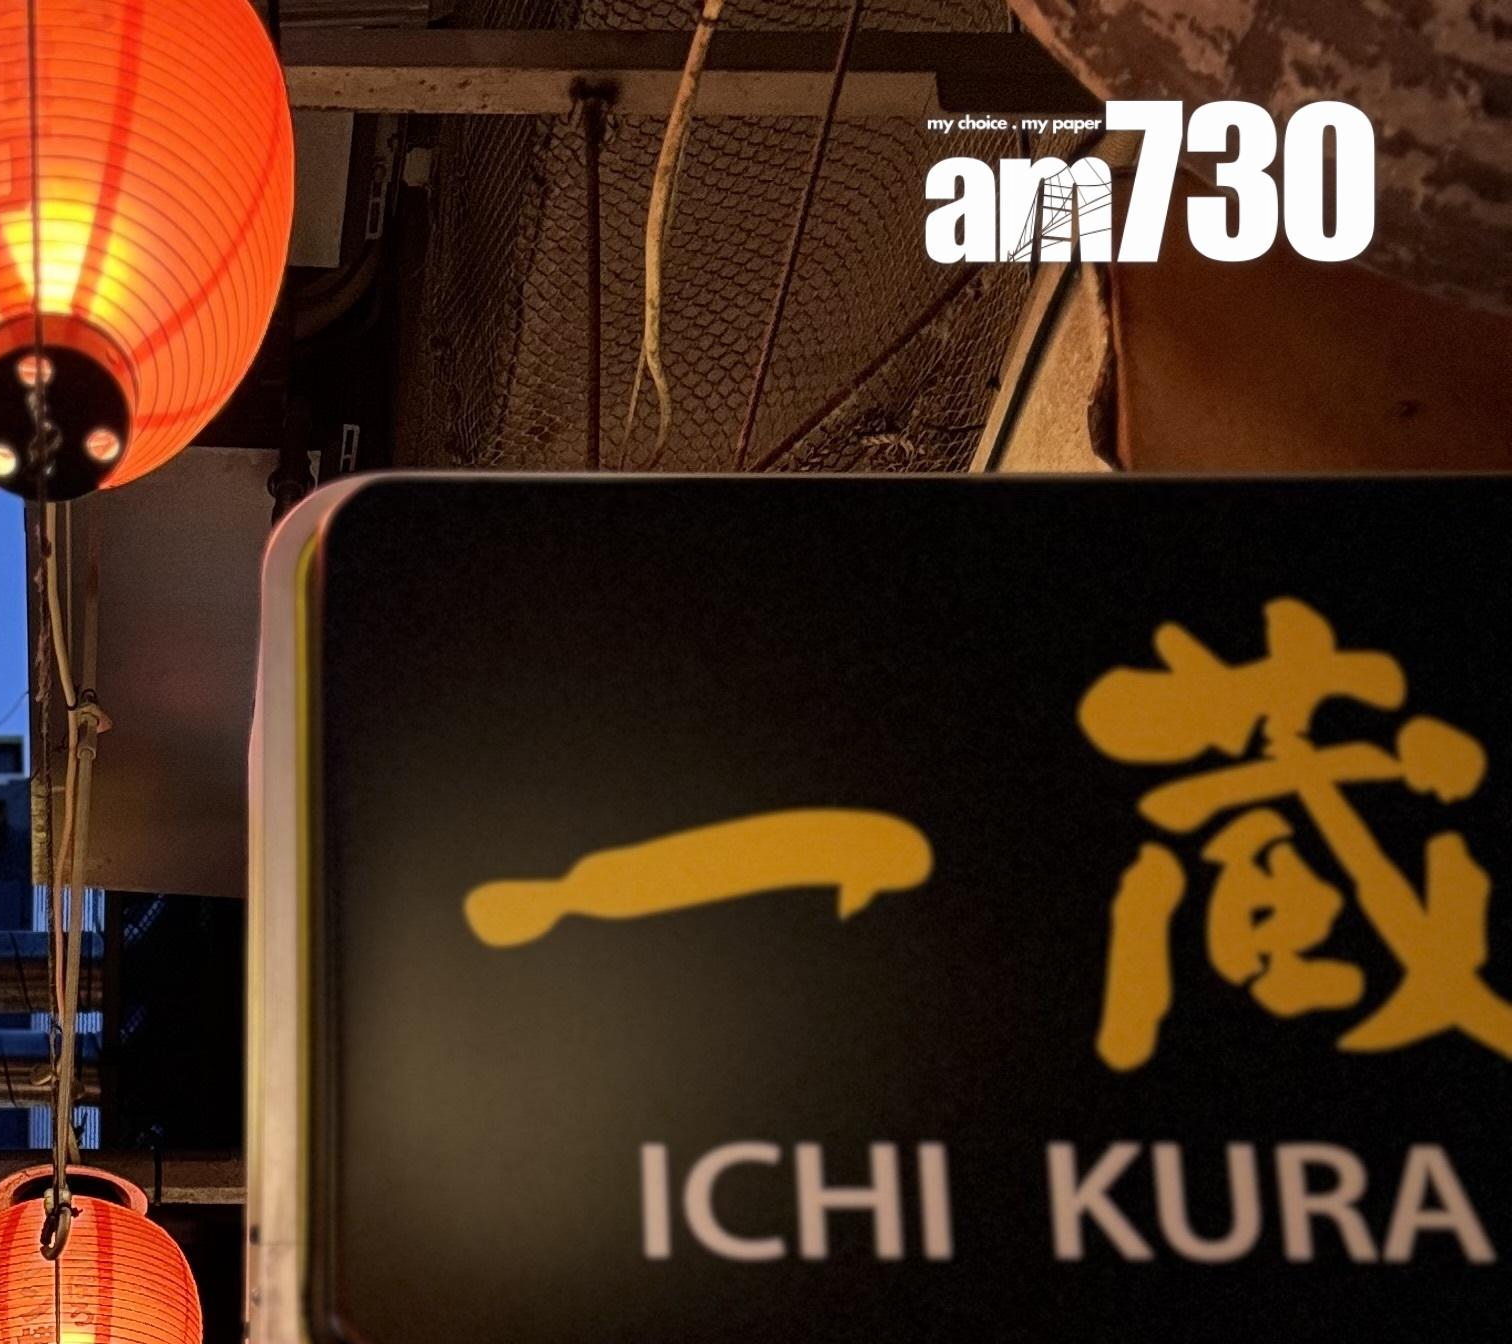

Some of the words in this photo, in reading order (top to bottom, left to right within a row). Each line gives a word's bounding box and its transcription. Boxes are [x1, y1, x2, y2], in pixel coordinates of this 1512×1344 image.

[465, 597, 1512, 1070] 一蔵
[641, 1142, 953, 1260] ICHI
[1048, 1142, 1496, 1263] KURA
